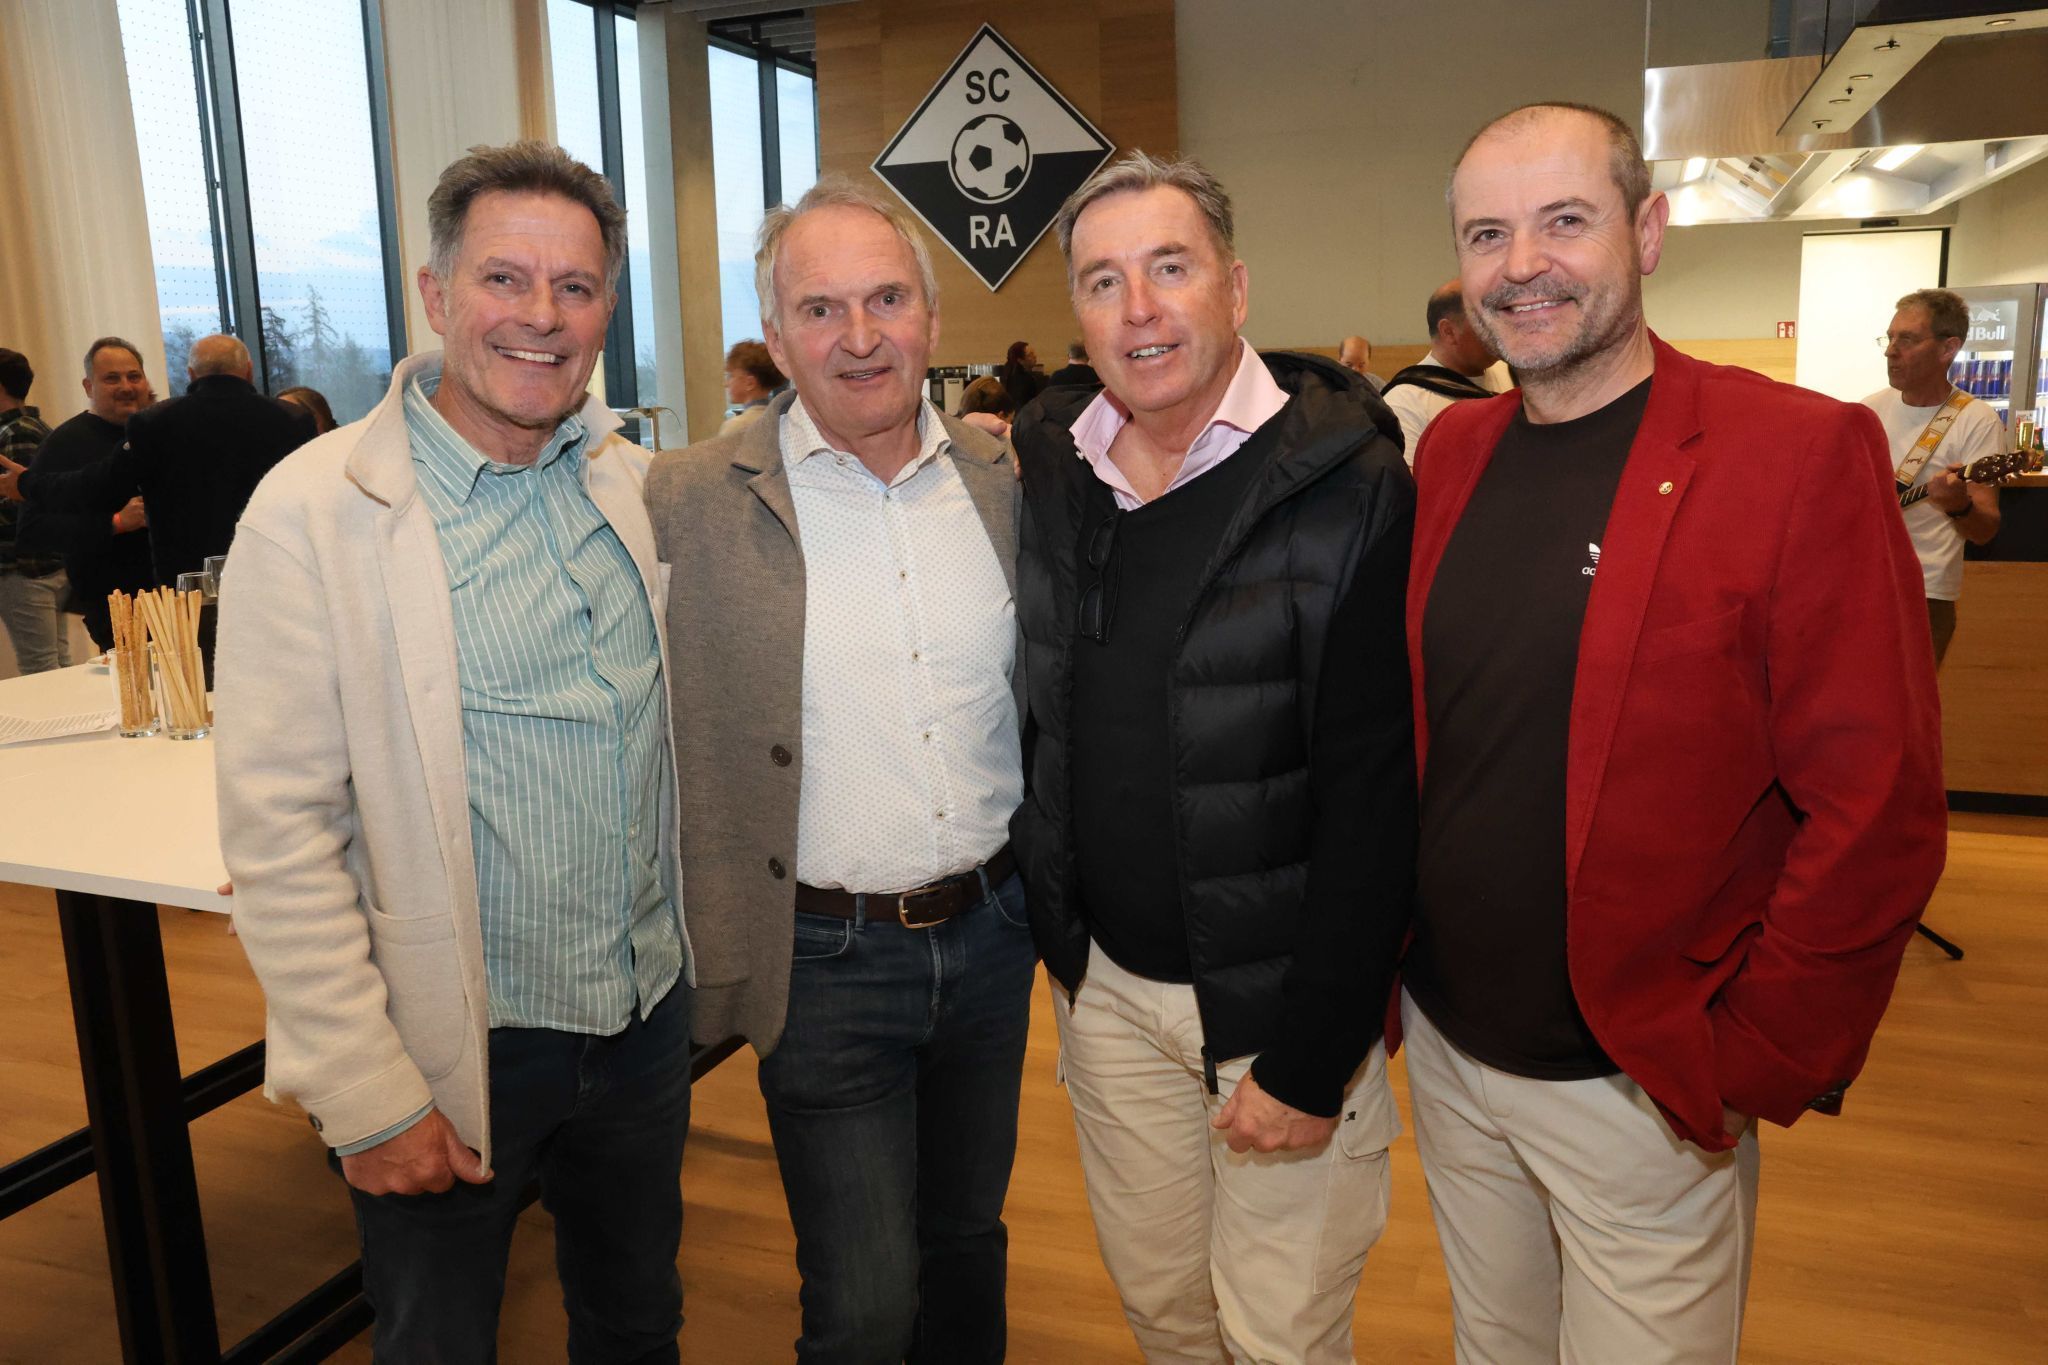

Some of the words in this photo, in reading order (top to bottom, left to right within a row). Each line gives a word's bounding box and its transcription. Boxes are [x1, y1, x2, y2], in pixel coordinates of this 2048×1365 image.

[965, 68, 1010, 104] SC
[969, 213, 1017, 249] RA
[1975, 325, 2006, 340] Bull
